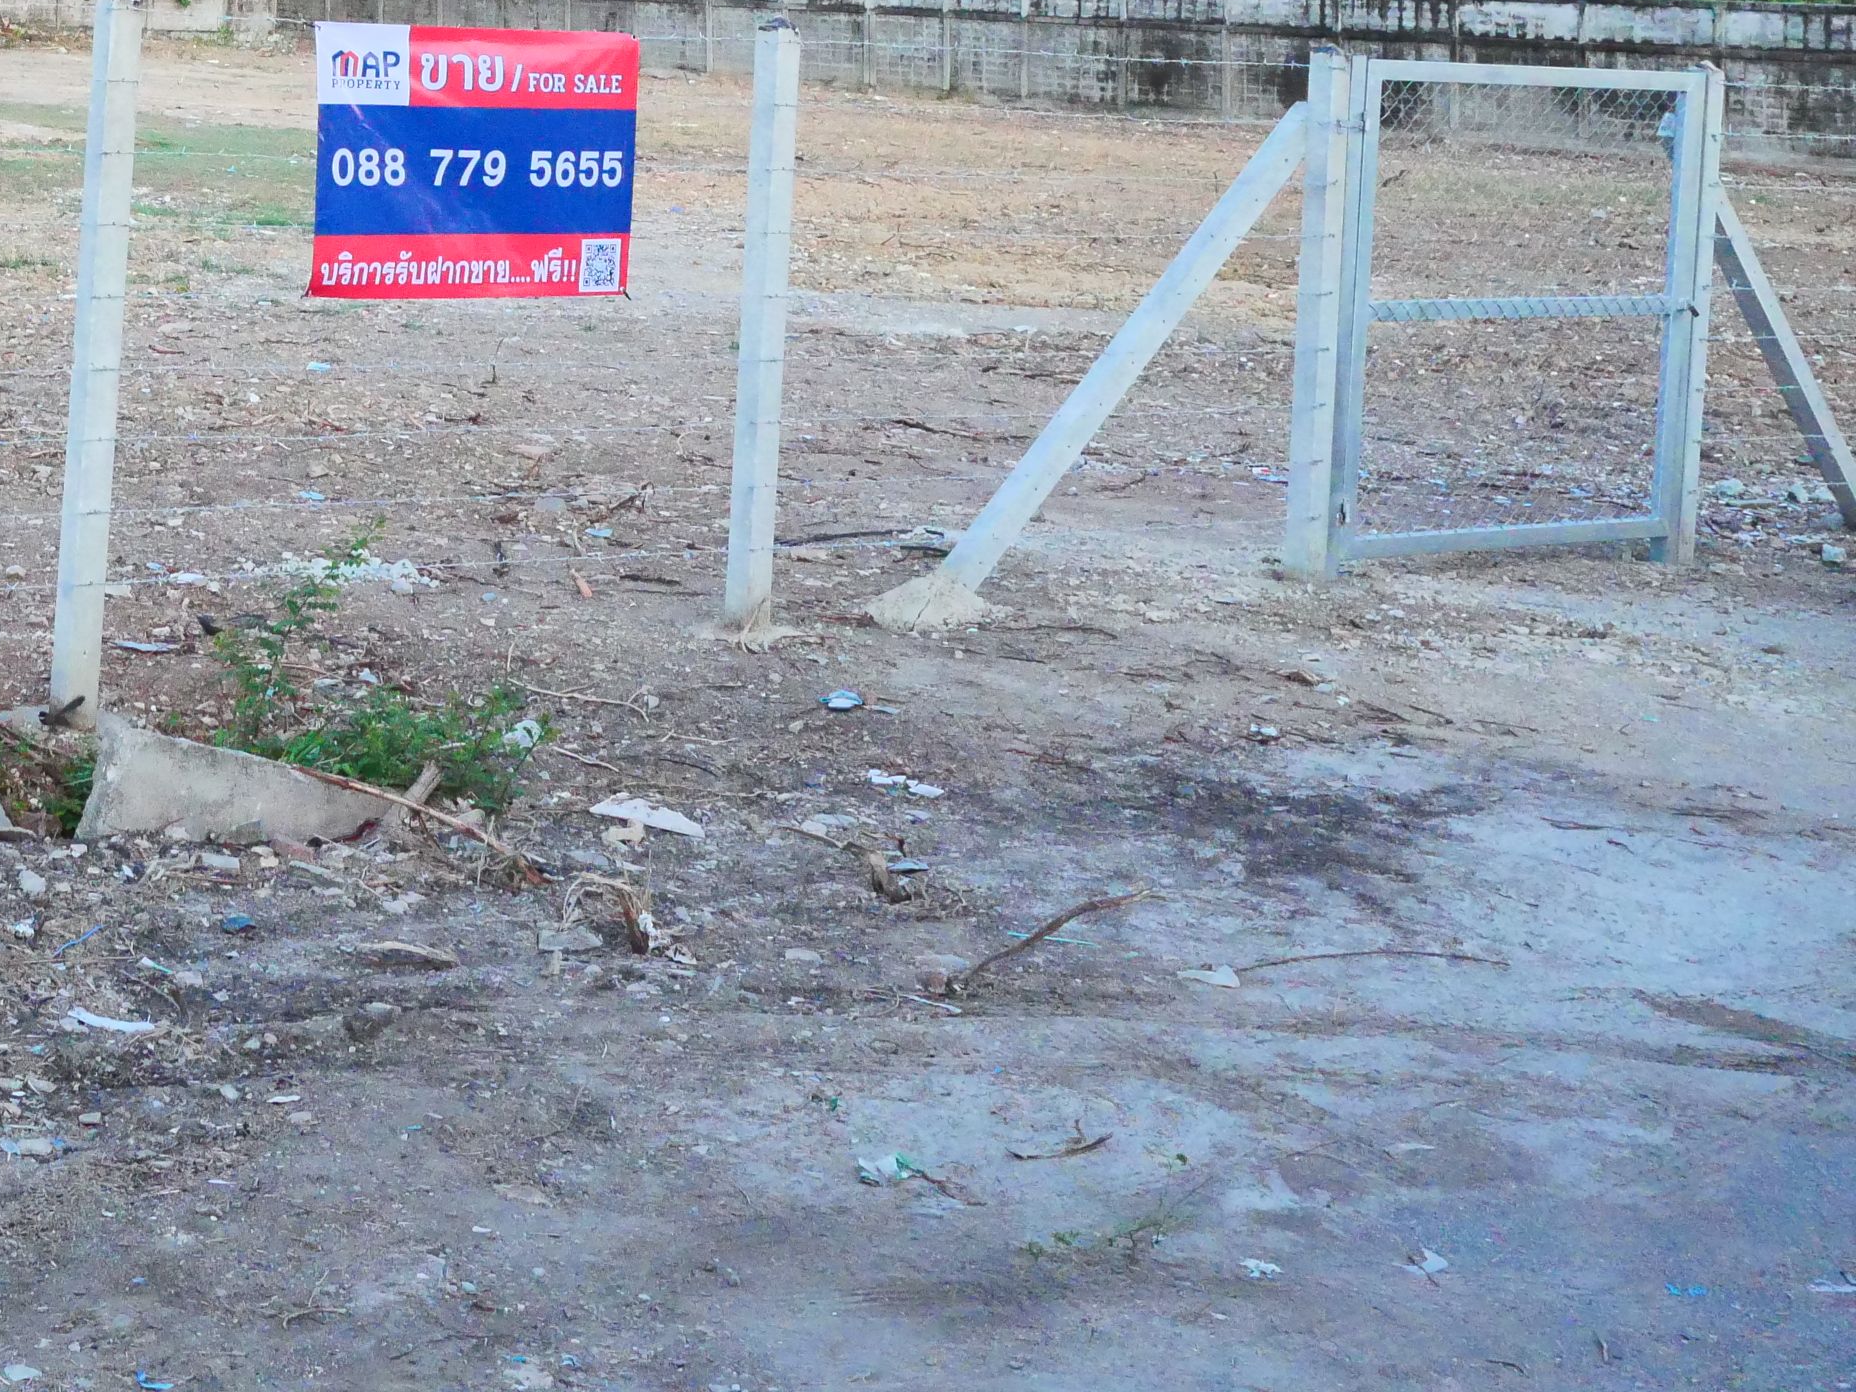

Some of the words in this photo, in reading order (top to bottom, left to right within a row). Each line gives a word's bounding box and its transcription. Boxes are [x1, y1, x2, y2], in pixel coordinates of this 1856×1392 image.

[331, 49, 401, 78] MAP
[420, 52, 505, 92] ขาย
[528, 74, 566, 93] FOR
[573, 74, 623, 94] SALE
[331, 78, 401, 90] PROPERTY
[331, 148, 406, 187] 088
[429, 149, 507, 187] 779
[529, 150, 623, 187] 5655
